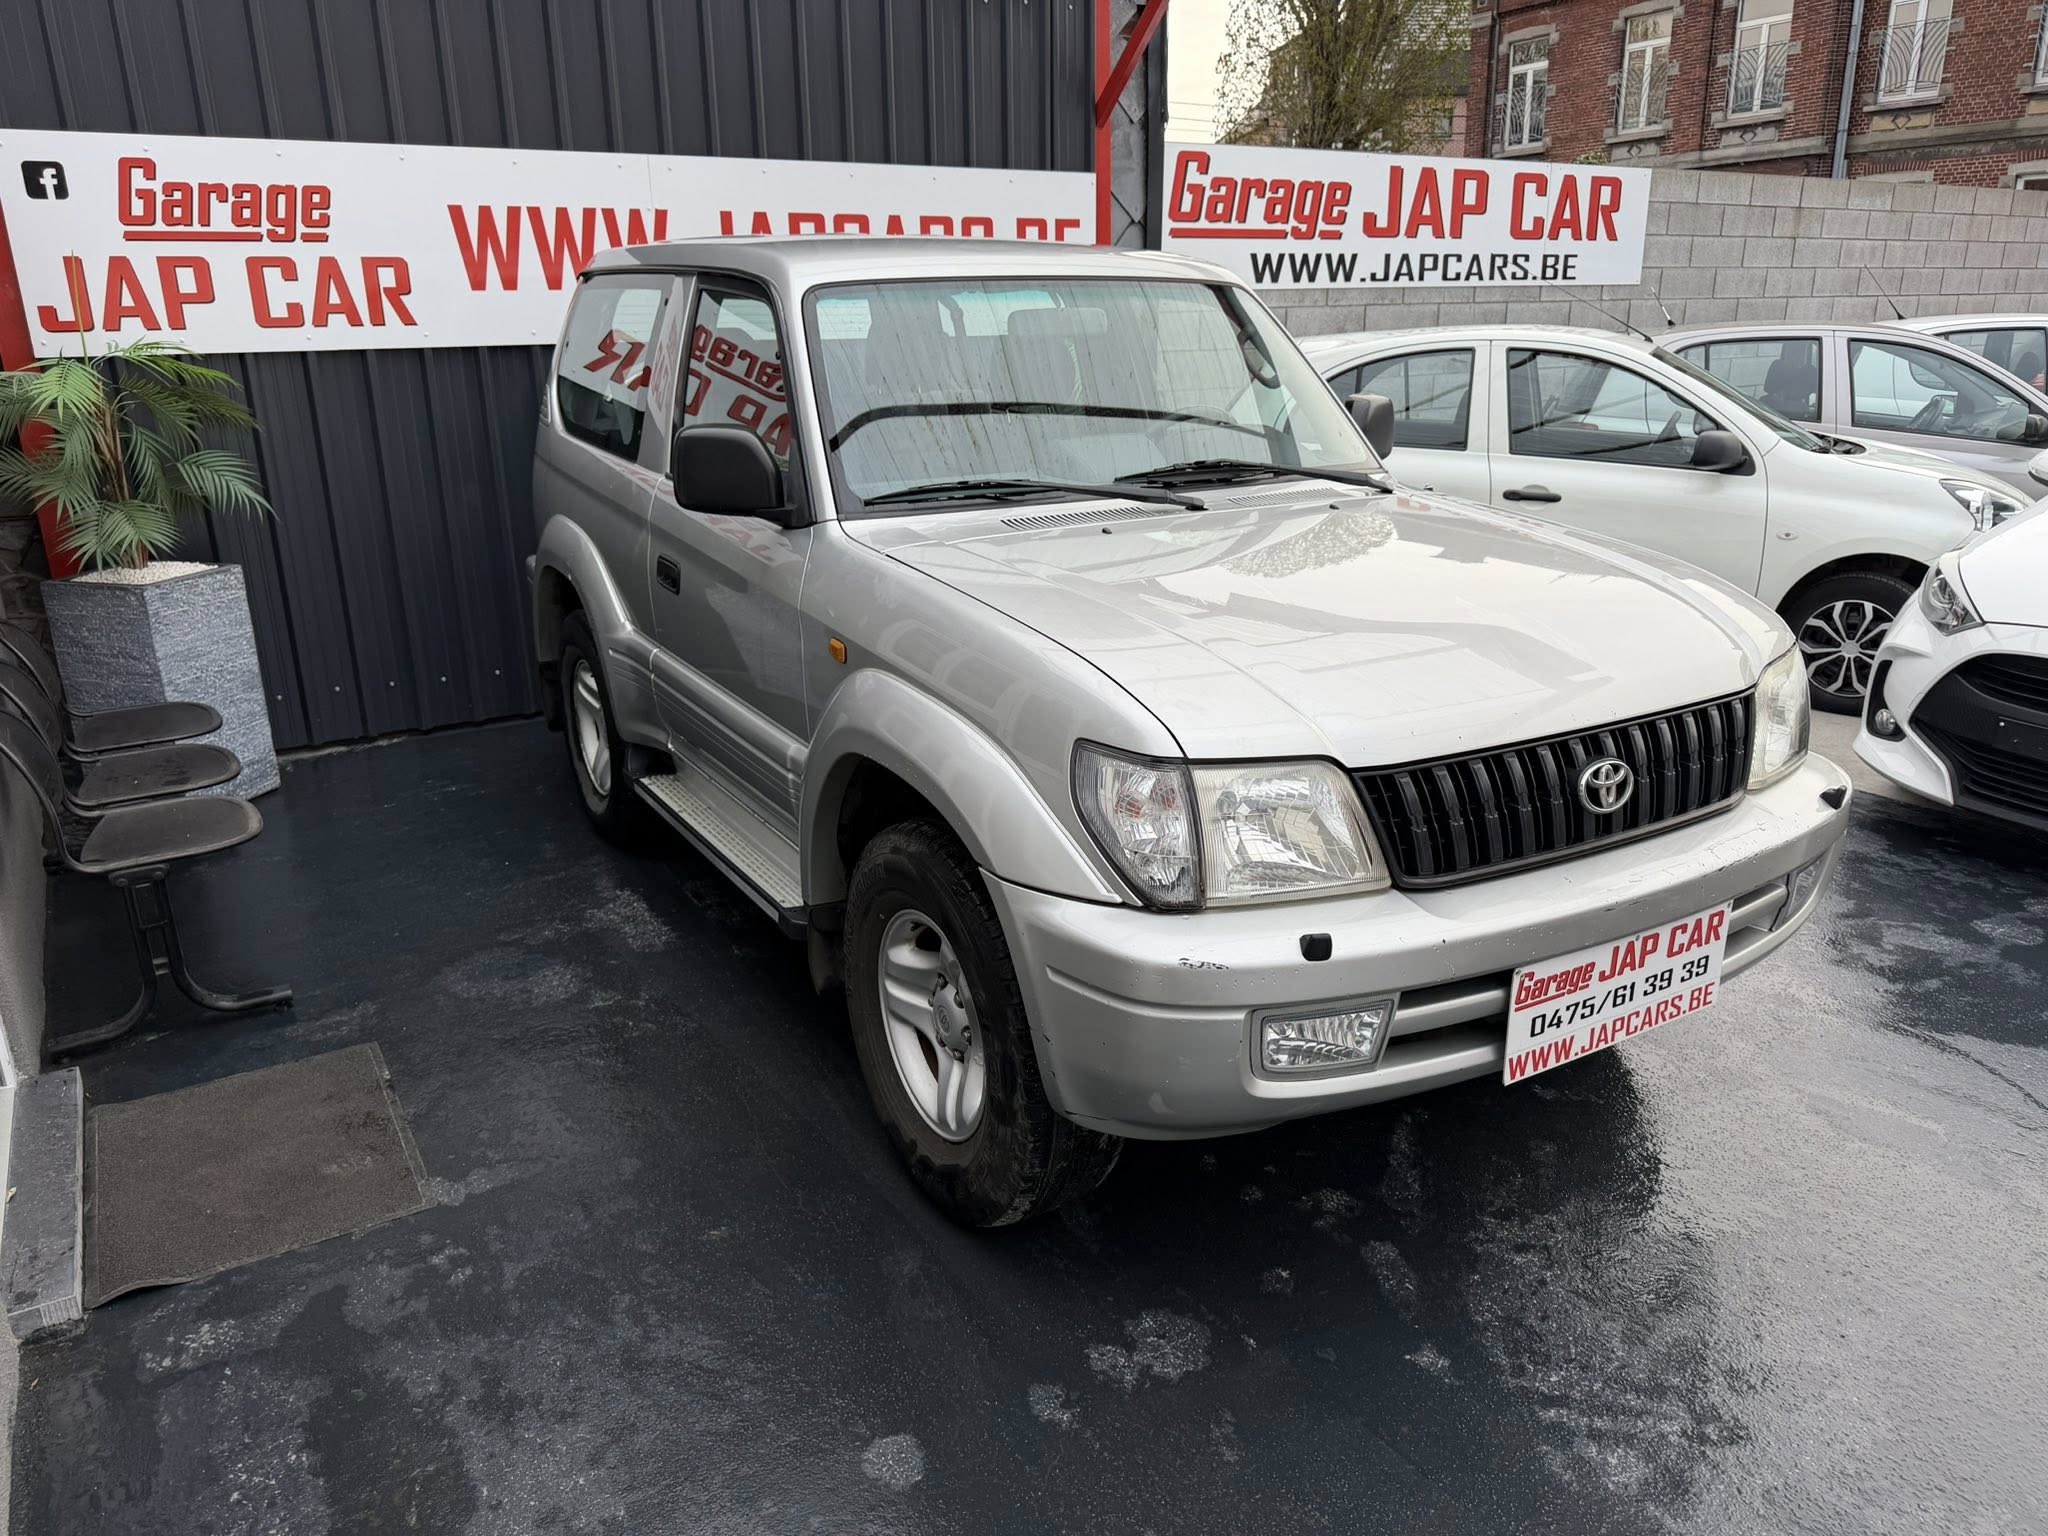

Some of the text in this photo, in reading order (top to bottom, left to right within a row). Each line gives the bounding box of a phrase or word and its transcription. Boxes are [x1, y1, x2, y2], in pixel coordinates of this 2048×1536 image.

[118, 157, 331, 242] Garage
[1168, 150, 1352, 240] Garage
[1363, 165, 1491, 239] JAP
[1510, 173, 1623, 242] CAR
[37, 256, 418, 333] JAP CAR
[1250, 252, 1578, 284] WWW.JAPCARS.BE
[1514, 909, 1725, 1010] Garage JAP CAR
[1530, 955, 1710, 1038] 0475/61 39 39
[1508, 982, 1716, 1081] WWW.JAPCARS.BE
